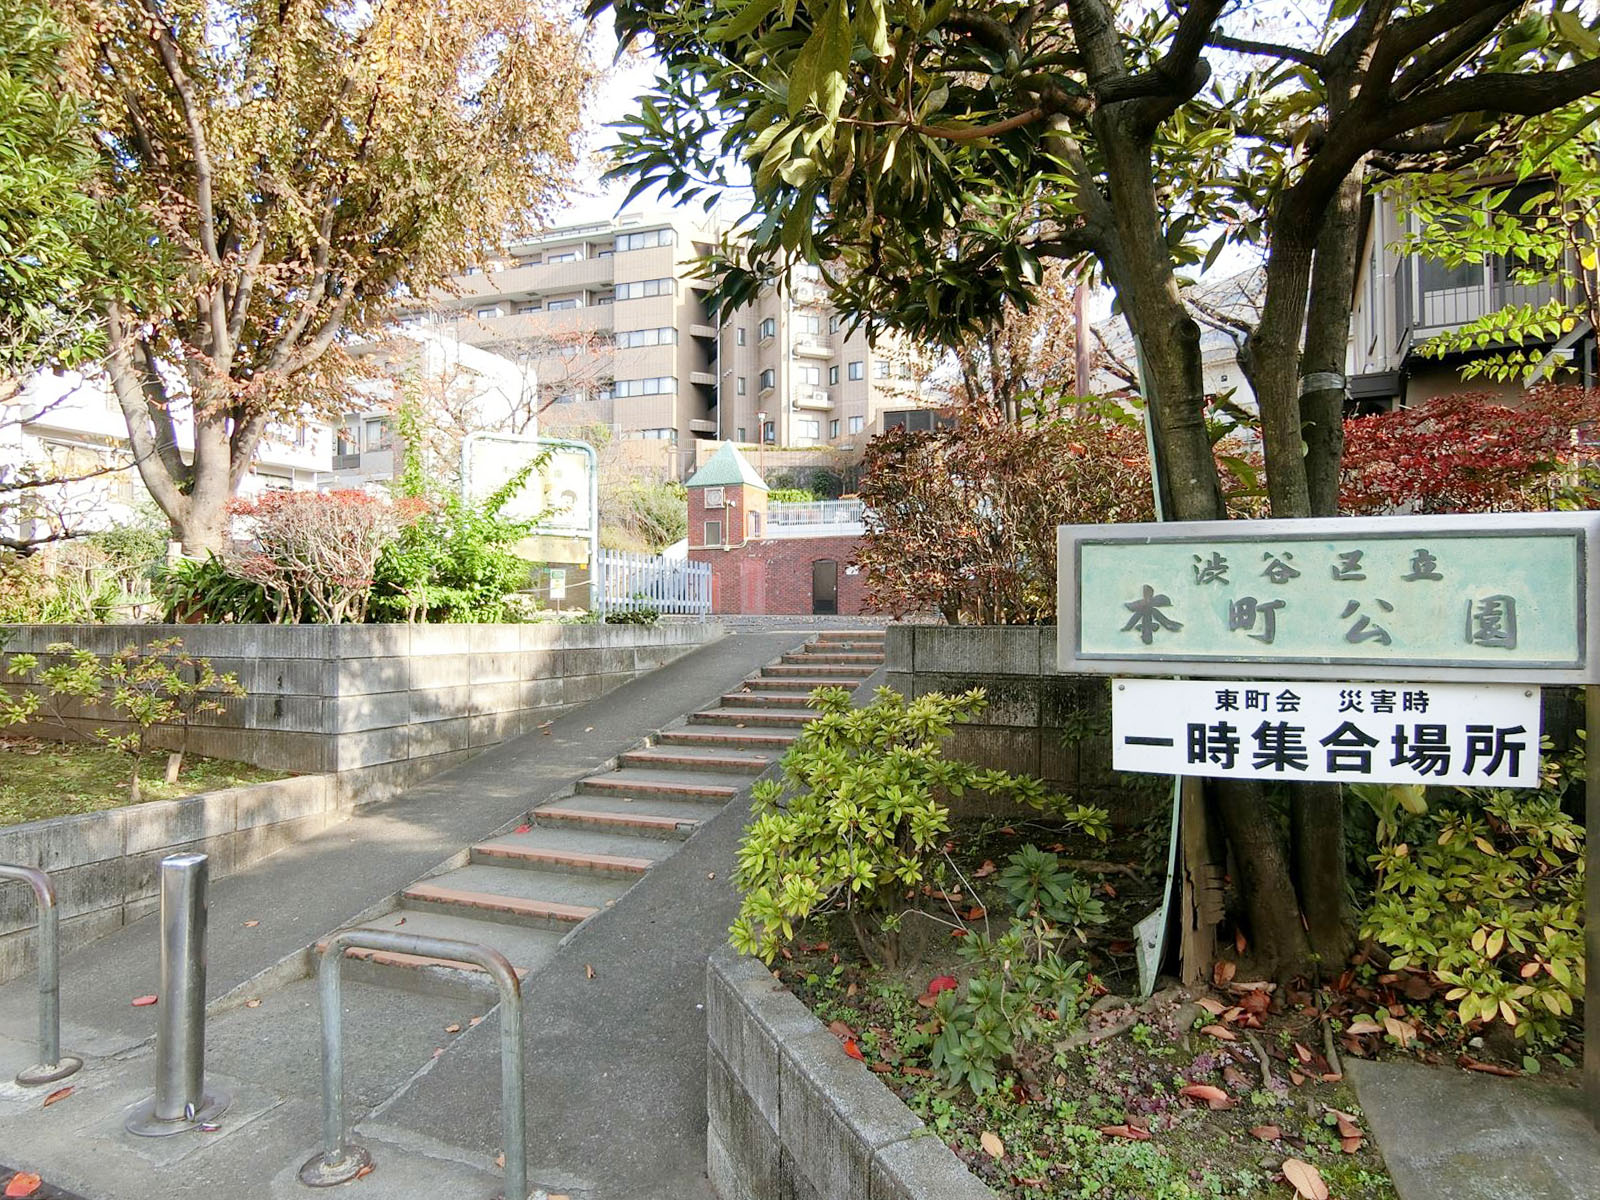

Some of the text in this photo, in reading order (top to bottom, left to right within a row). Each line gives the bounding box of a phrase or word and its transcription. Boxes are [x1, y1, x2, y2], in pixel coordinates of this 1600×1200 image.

[1192, 549, 1443, 584] 渋谷区立
[1121, 585, 1518, 649] 本町公園
[1215, 689, 1430, 714] 東町会 災害時
[1124, 721, 1527, 777] 一時集合場所
